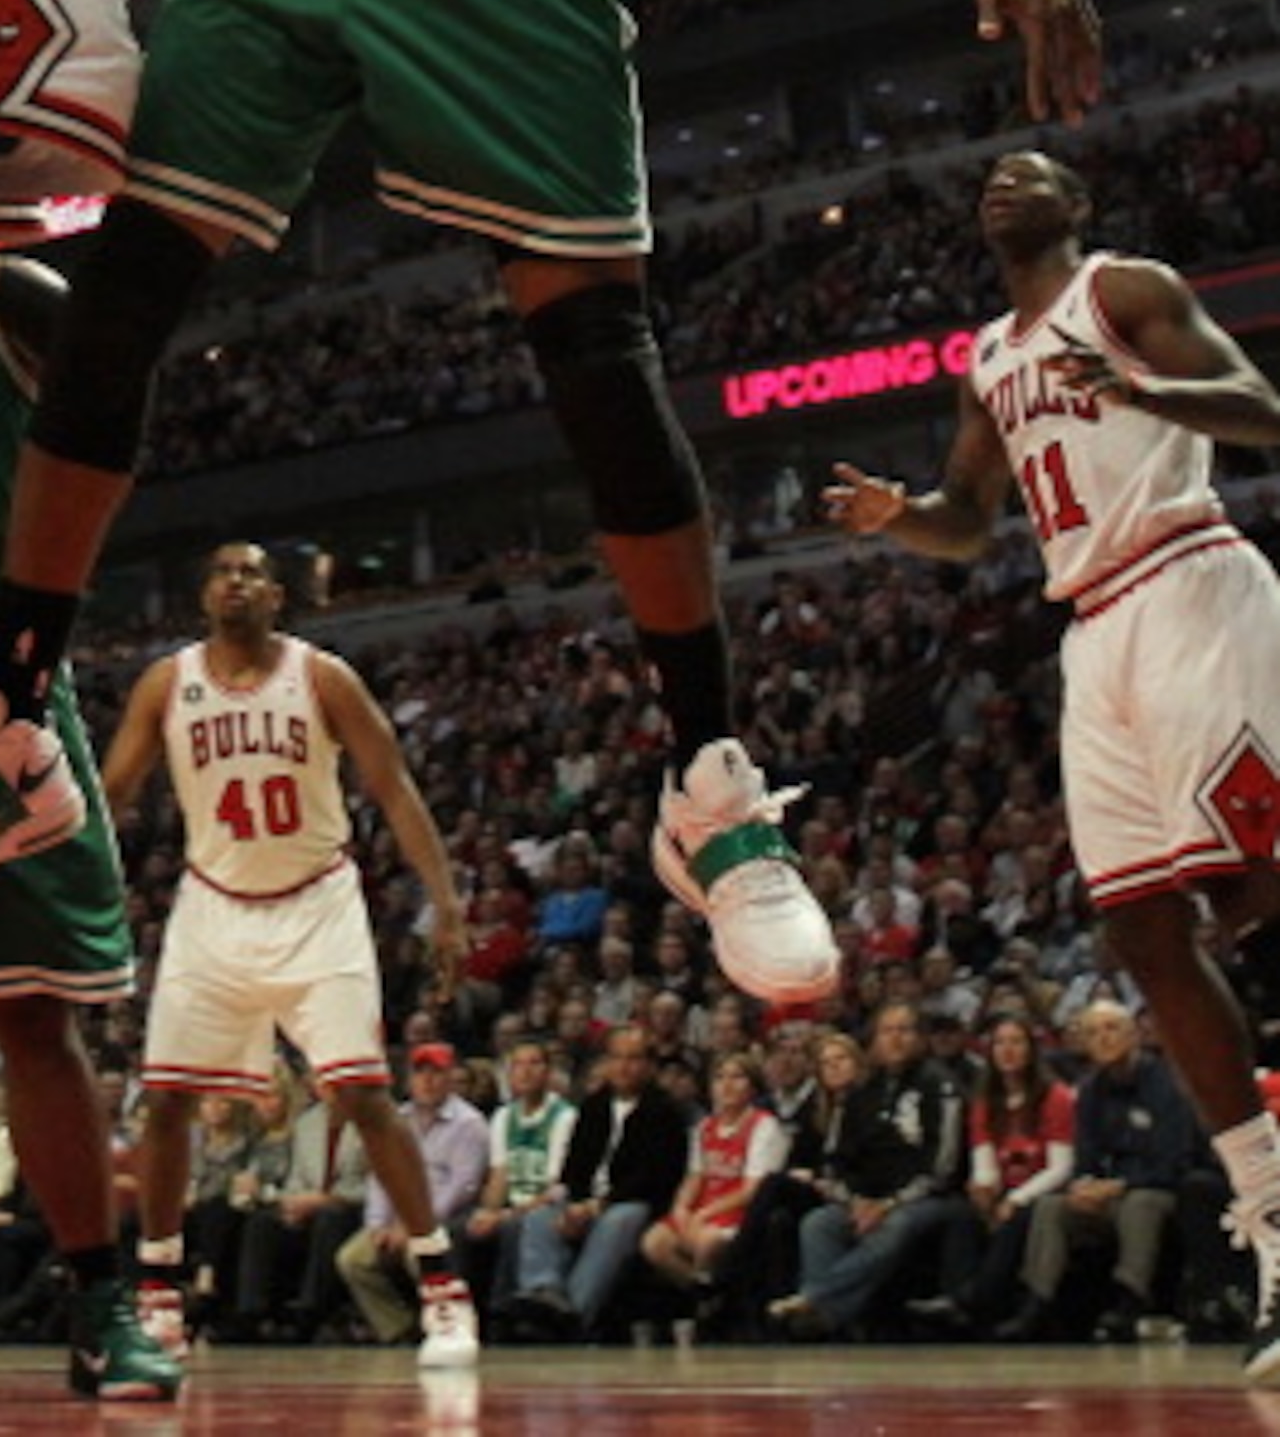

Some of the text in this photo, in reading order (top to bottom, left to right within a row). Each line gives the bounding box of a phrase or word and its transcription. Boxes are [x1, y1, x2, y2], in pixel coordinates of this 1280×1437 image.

[724, 340, 937, 419] UPCOMING
[1020, 440, 1090, 542] 11
[190, 711, 309, 769] BULLS
[216, 774, 302, 841] 40
